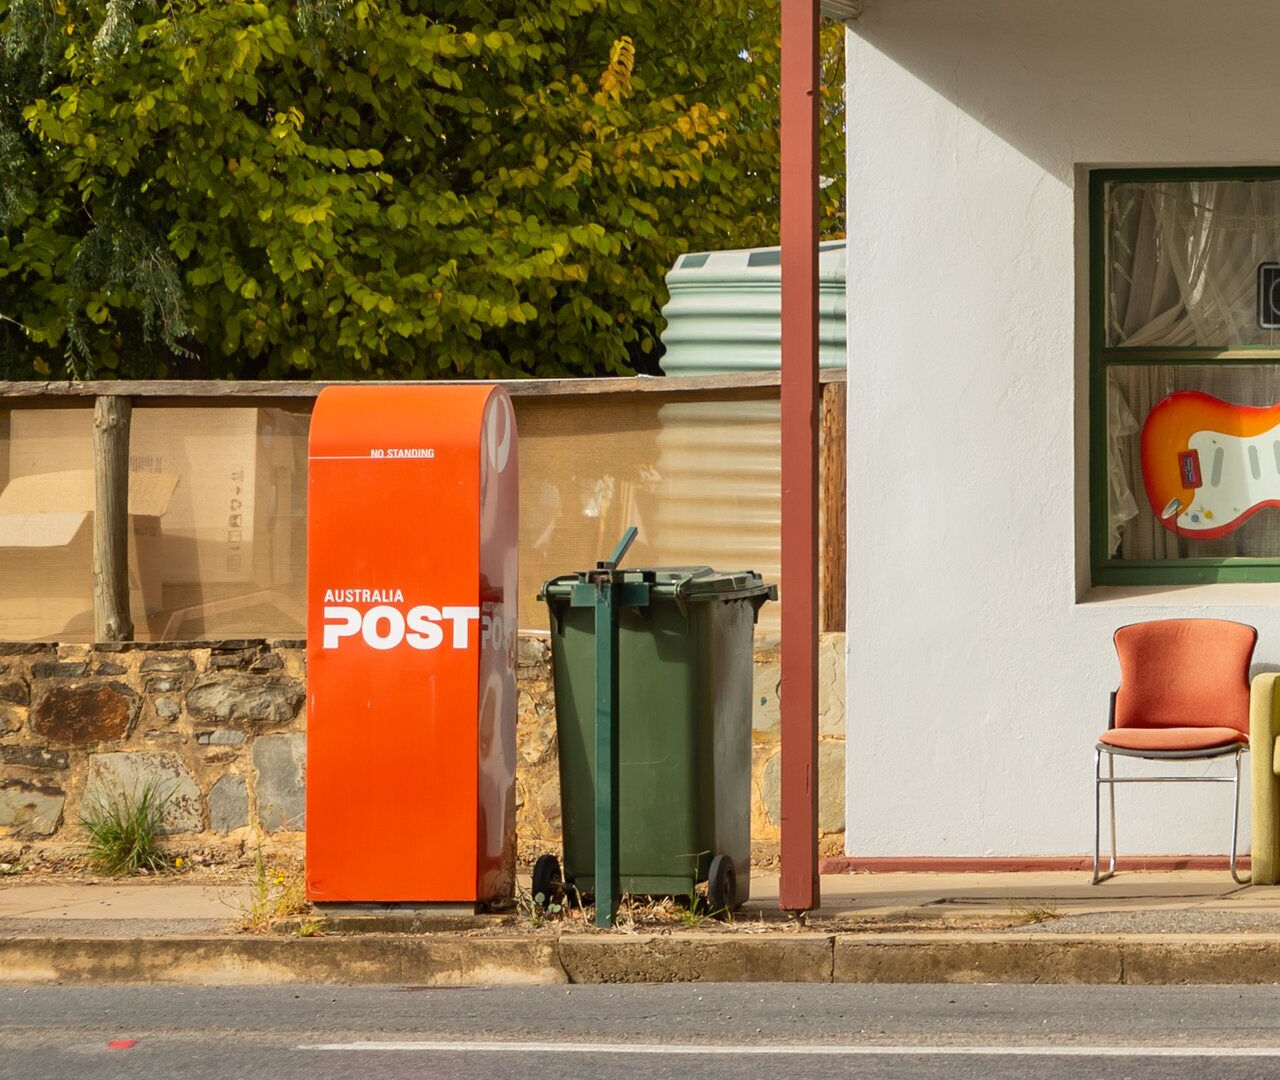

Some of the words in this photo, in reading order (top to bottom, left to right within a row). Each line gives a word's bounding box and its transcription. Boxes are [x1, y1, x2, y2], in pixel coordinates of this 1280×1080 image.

[371, 449, 384, 458] NO
[387, 449, 434, 458] STANDING
[324, 589, 404, 602] AUSTRALIA
[322, 605, 480, 650] POST
